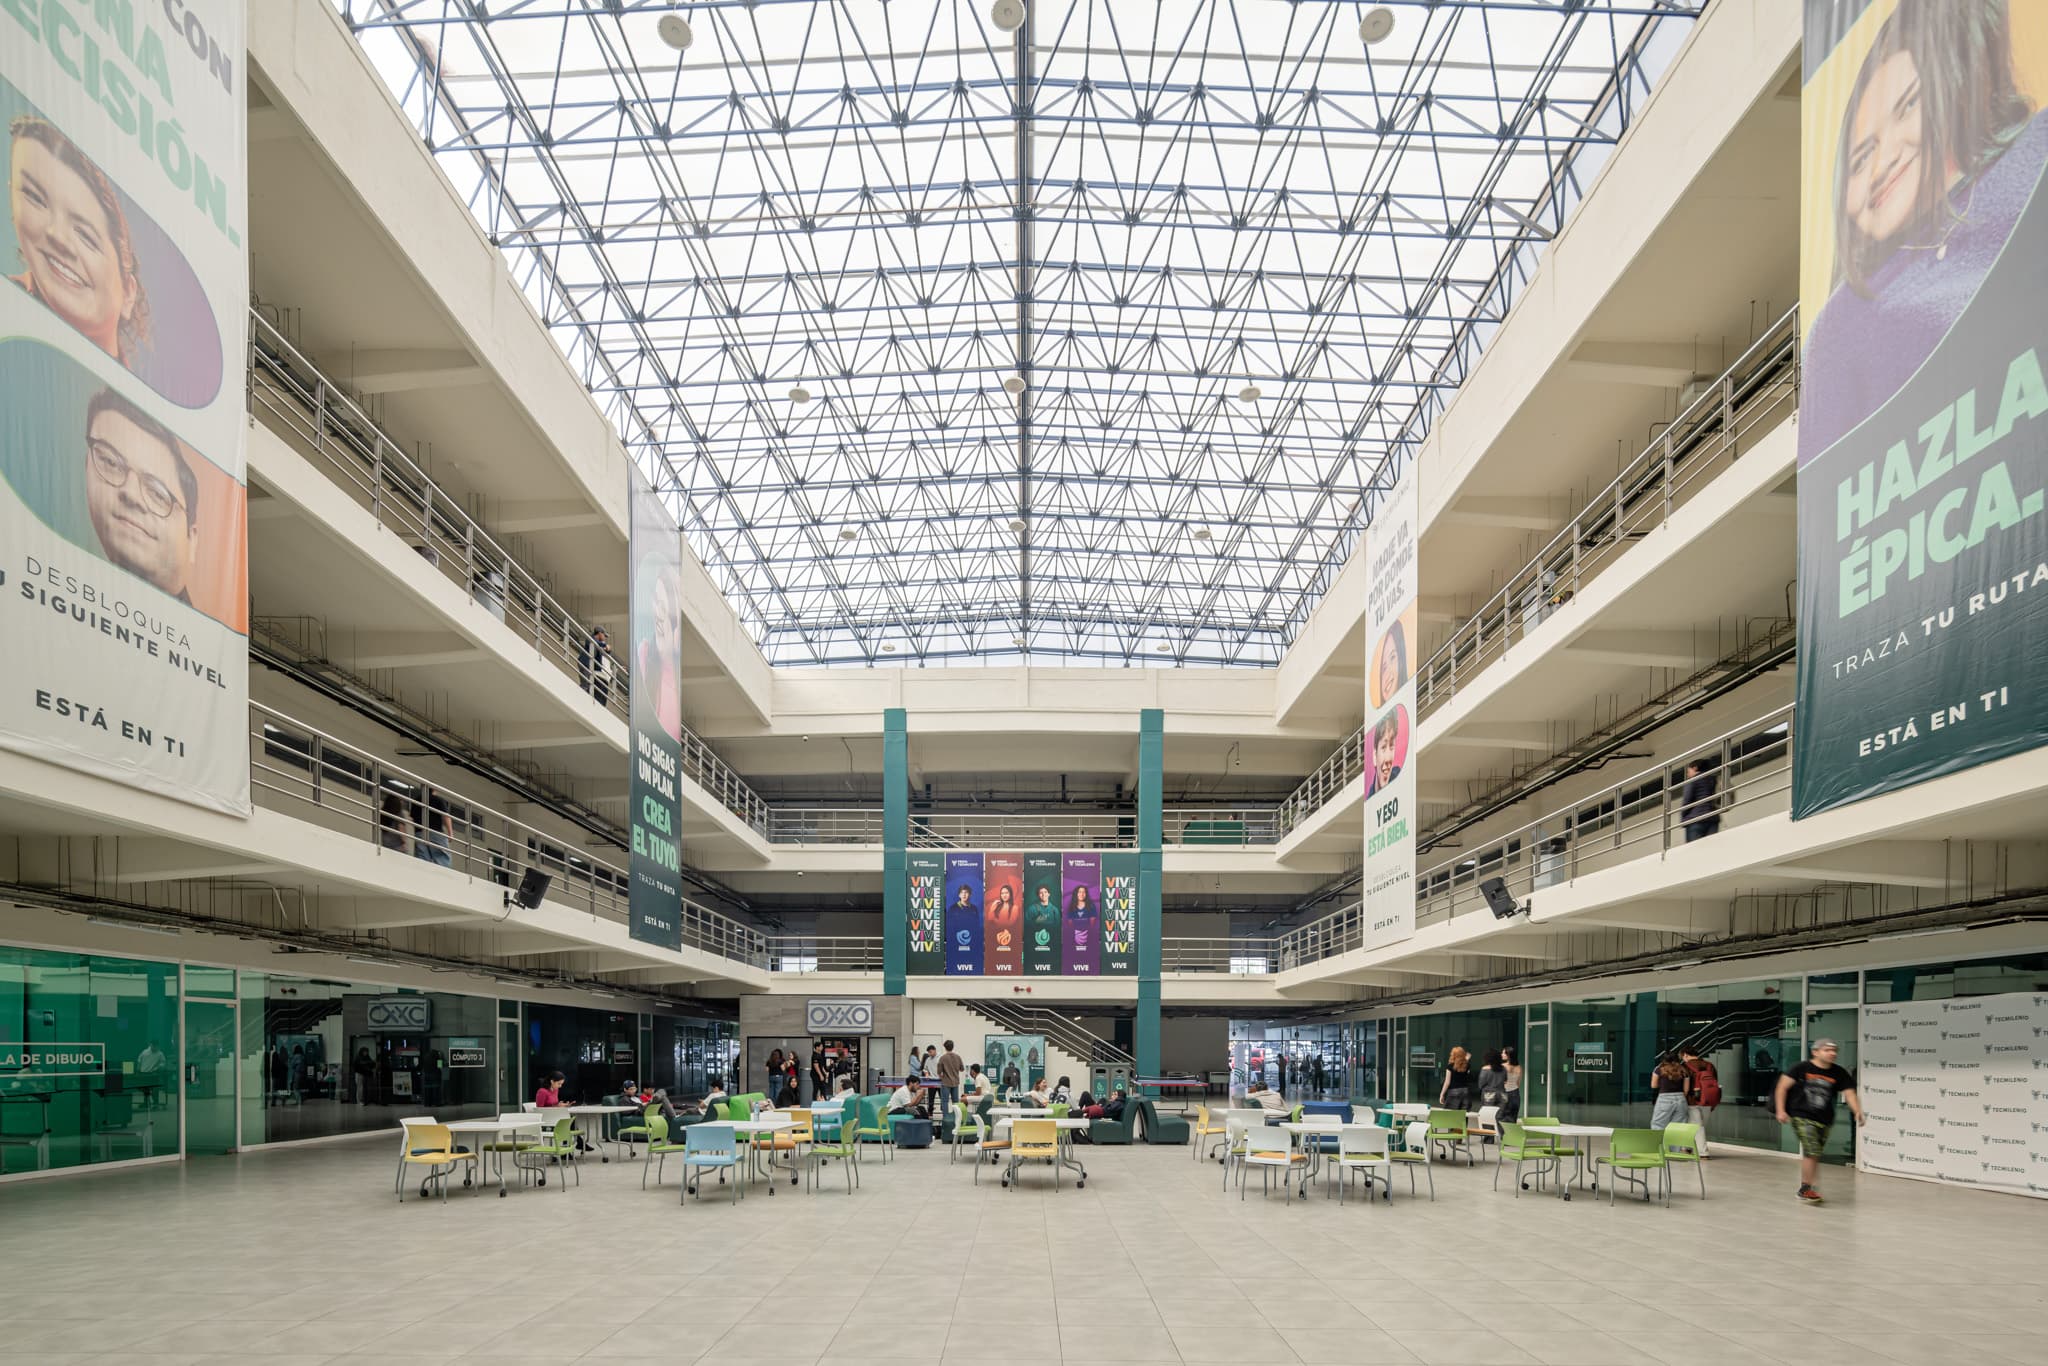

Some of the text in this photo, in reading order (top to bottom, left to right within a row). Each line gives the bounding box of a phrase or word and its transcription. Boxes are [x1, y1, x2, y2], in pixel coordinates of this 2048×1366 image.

[1836, 347, 2048, 544] HAZLA
[1838, 461, 2045, 619] ÉPICA.
[1372, 534, 1396, 582] NADIE
[1368, 578, 1383, 613] POR
[26, 555, 191, 651] DESBLOQUEA
[1832, 562, 2048, 680] TRAZA TU RUTA
[20, 581, 227, 689] SIGUIENTE NIVEL
[35, 689, 185, 758] ESTÁ EN TI
[1859, 686, 2008, 757] ESTÁ EN TI
[638, 731, 676, 777] NO SIGAS
[638, 757, 676, 802] UN PLAN.
[643, 795, 672, 836] CREA
[1376, 797, 1399, 828] Y ESO
[1368, 818, 1409, 858] ESTÁ BIEN.
[633, 823, 679, 873] EL TUYO.
[911, 876, 940, 888] VIVE
[1106, 877, 1136, 888] VIVE
[911, 887, 940, 898] VIVE
[1106, 888, 1136, 898] VIVE
[911, 898, 940, 908] VIVE
[1106, 898, 1136, 910] VIVE
[911, 909, 940, 920] VIVE
[1105, 910, 1136, 920] VIVE
[911, 920, 940, 930] VIVE
[1105, 920, 1134, 931] VIVE
[911, 930, 940, 941] VIVE
[1105, 931, 1134, 942] VIVE
[911, 942, 940, 952] VIVE
[1105, 942, 1134, 953] VIVE
[810, 1007, 869, 1025] OXXO
[20, 1054, 41, 1065] DE
[45, 1053, 94, 1065] DIBUJO
[452, 1051, 478, 1061] CÓMPUTO
[1577, 1056, 1603, 1066] CÓMPUTO
